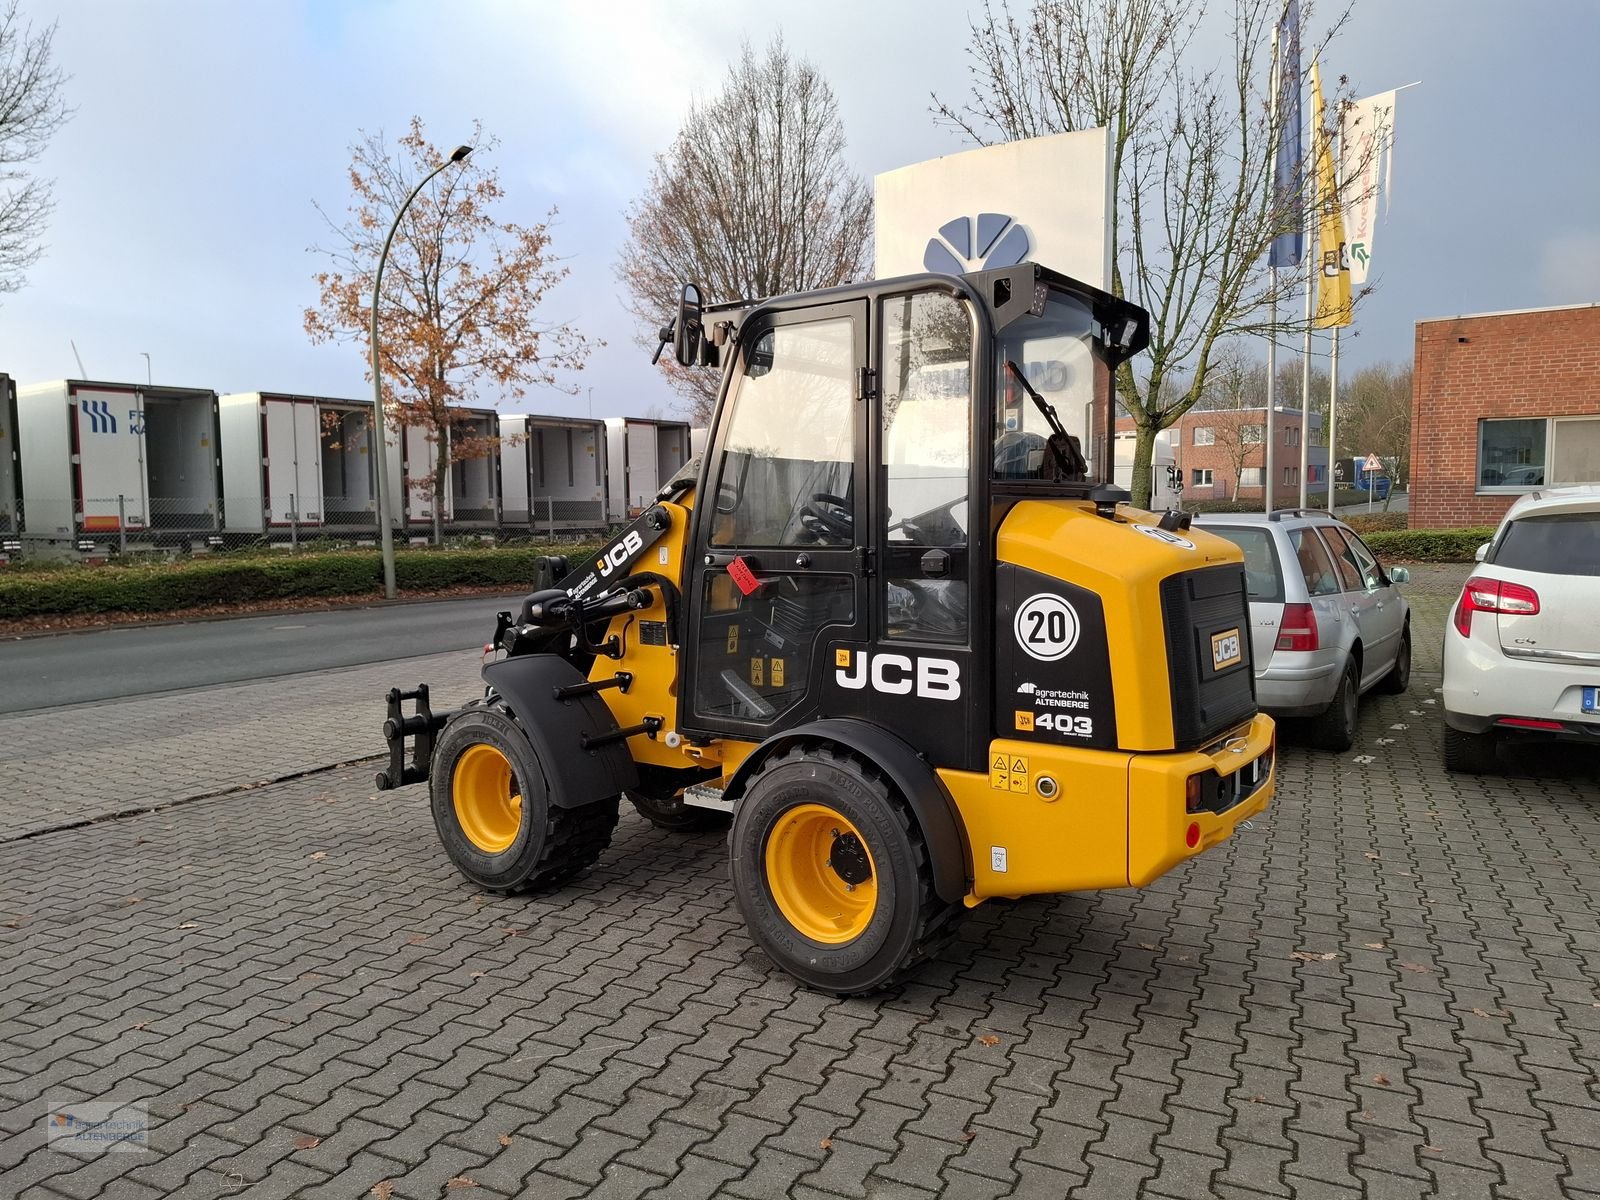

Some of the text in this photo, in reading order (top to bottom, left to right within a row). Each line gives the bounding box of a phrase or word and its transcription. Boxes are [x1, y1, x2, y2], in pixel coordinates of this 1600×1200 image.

[598, 530, 643, 577] JCB
[1028, 610, 1066, 644] 20
[1215, 636, 1238, 662] JCB
[835, 651, 961, 701] JCB
[1035, 689, 1089, 700] agrartechnik
[1035, 698, 1089, 709] ALTENBERGE
[1035, 713, 1093, 734] 403
[838, 777, 863, 798] SKID
